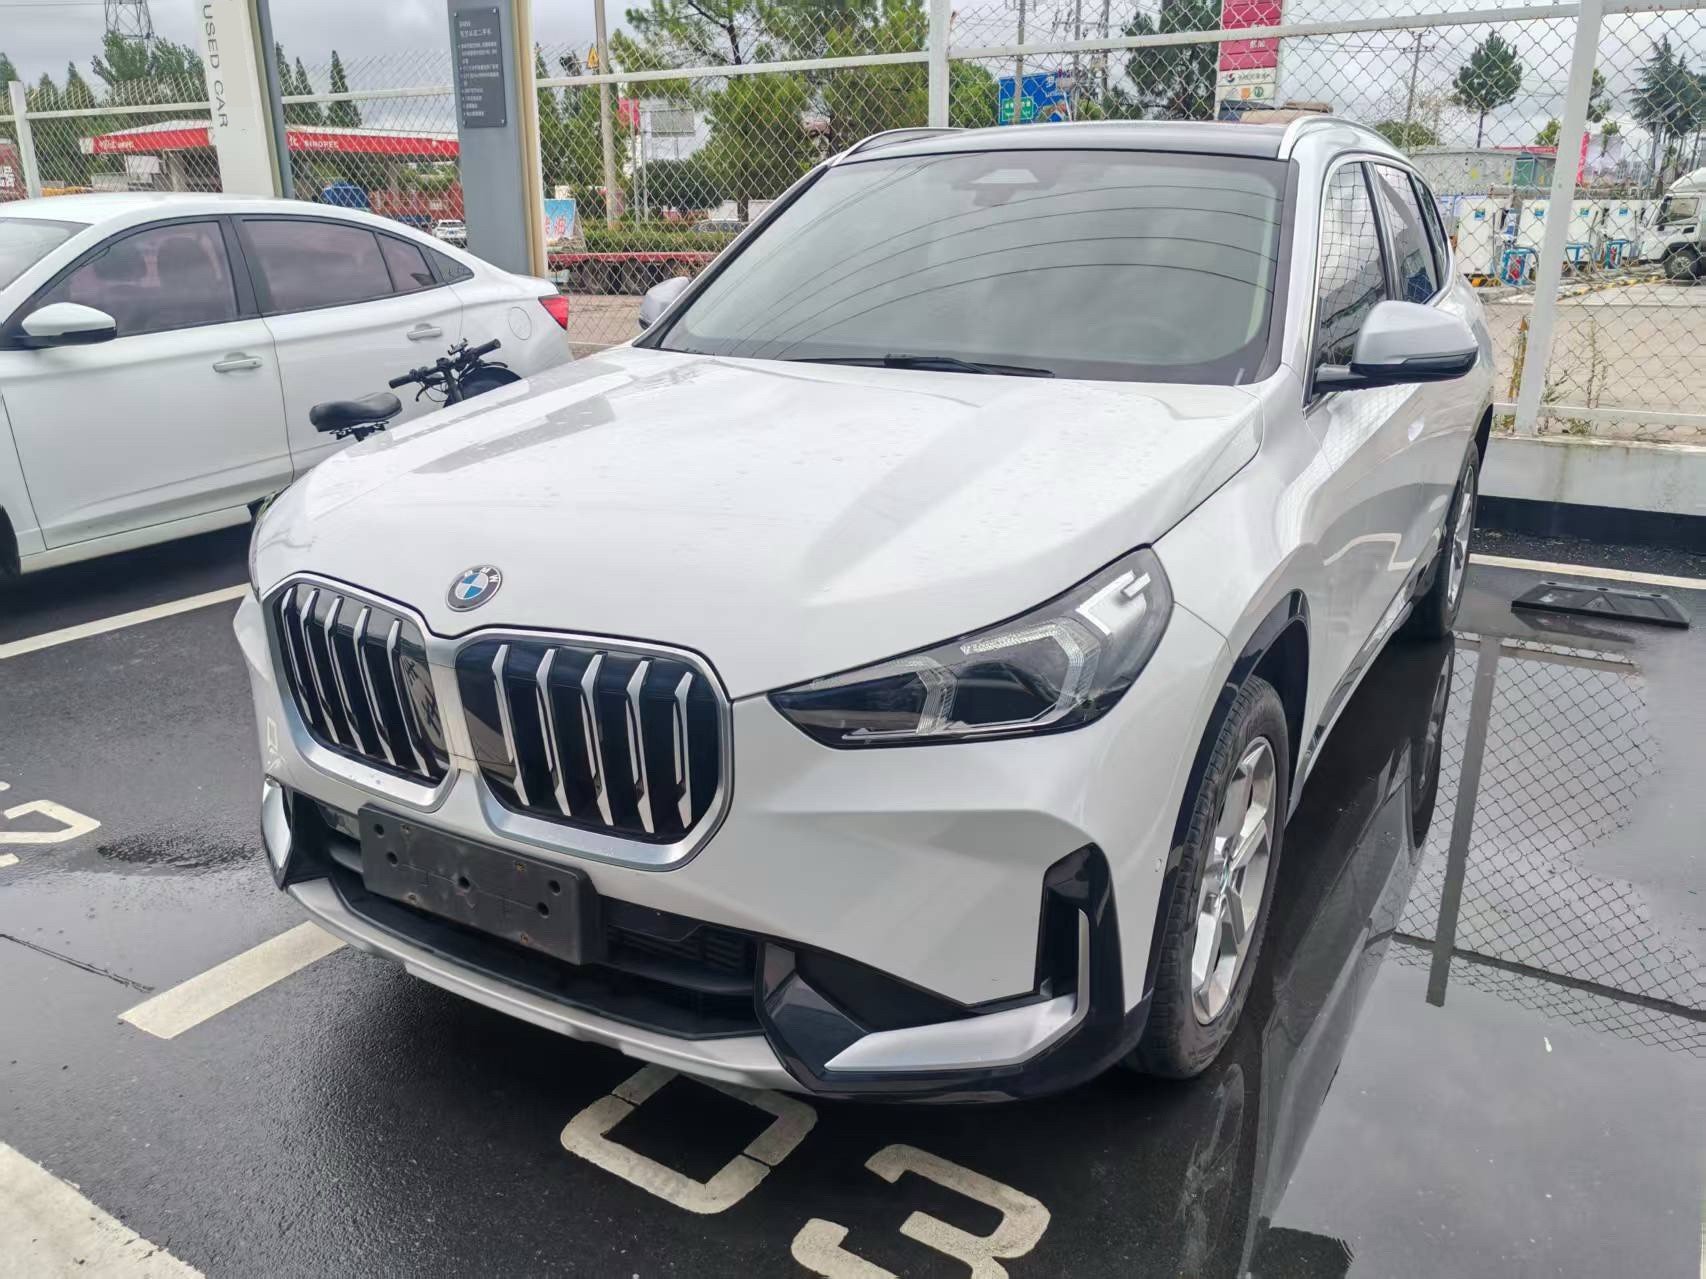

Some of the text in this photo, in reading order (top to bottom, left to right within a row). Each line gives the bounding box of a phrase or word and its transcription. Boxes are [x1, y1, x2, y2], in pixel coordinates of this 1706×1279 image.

[203, 4, 229, 128] USED CAR
[464, 566, 500, 584] BMW
